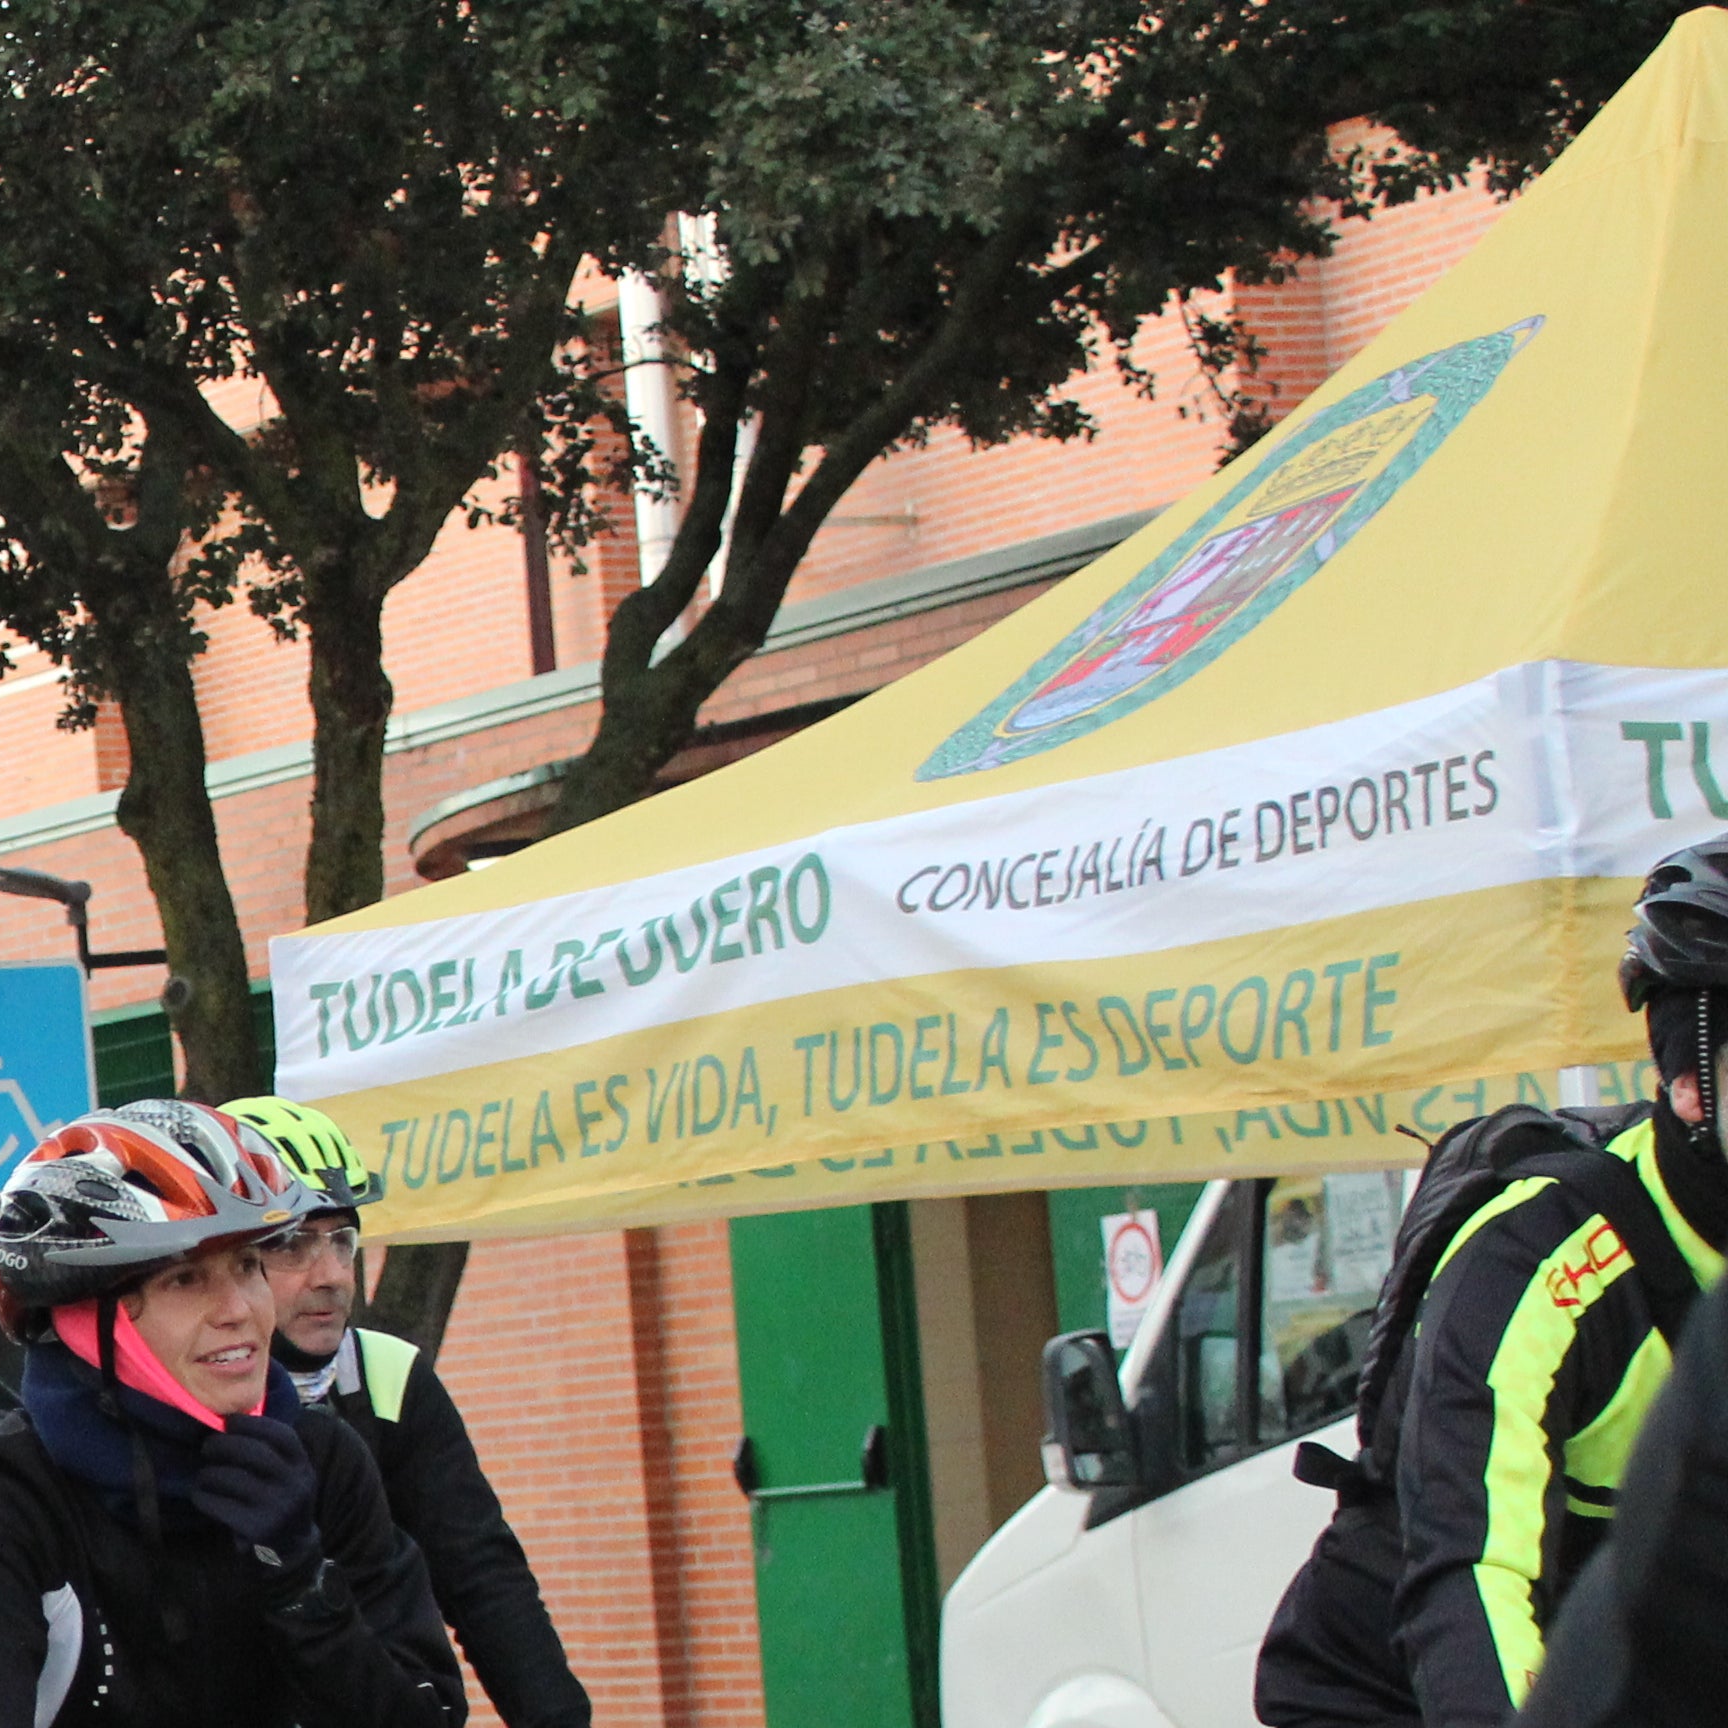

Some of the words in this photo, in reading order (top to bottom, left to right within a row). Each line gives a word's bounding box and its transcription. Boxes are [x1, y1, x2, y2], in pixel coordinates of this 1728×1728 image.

[896, 817, 1166, 914] CONCEJALÍA
[1179, 808, 1242, 877] DE
[1254, 750, 1499, 864] DEPORTES
[310, 948, 524, 1059] TUDELA
[379, 1087, 562, 1199] TUDELA
[576, 1077, 630, 1160] ES
[645, 1053, 777, 1145] VIDA,
[793, 1006, 1011, 1119] TUDELA
[1029, 1000, 1100, 1084] ES
[1099, 951, 1400, 1078] DEPORTE
